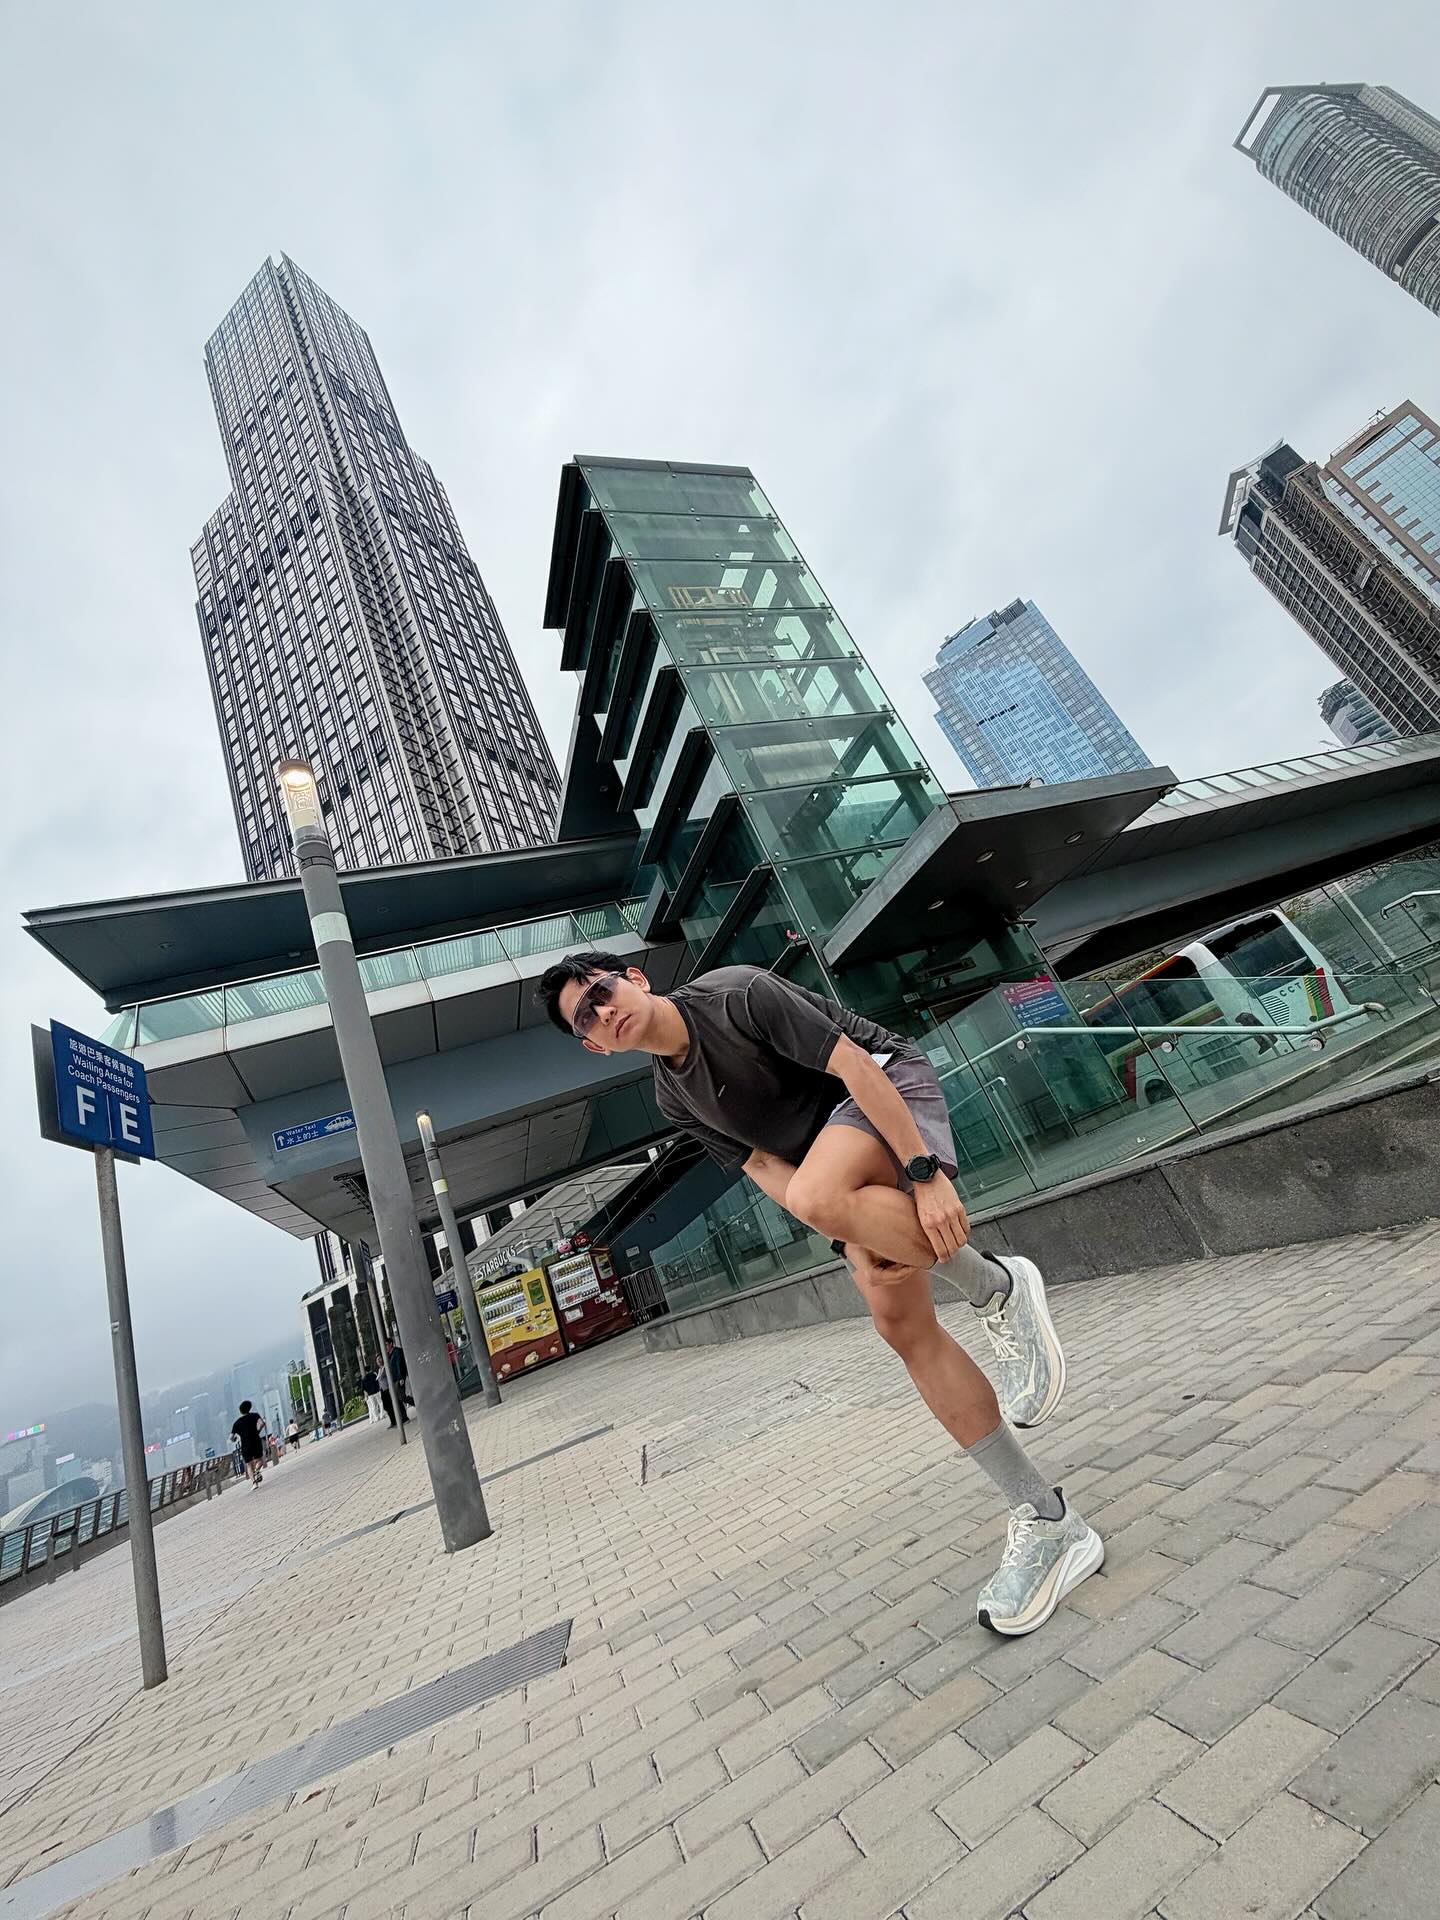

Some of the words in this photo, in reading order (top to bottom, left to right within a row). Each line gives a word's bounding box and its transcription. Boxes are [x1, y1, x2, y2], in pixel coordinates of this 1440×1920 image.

[1279, 982, 1302, 997] CCT
[67, 1064, 95, 1086] Coach
[96, 1076, 140, 1104] Passengers
[73, 1053, 104, 1078] Waiting
[105, 1068, 122, 1084] Area
[123, 1077, 133, 1089] for
[76, 1084, 96, 1126] F
[119, 1102, 141, 1145] E
[286, 1128, 303, 1136] Water
[305, 1123, 317, 1131] Taxi
[286, 1130, 319, 1144] 水上的士
[475, 1245, 516, 1282] STARBUCKS
